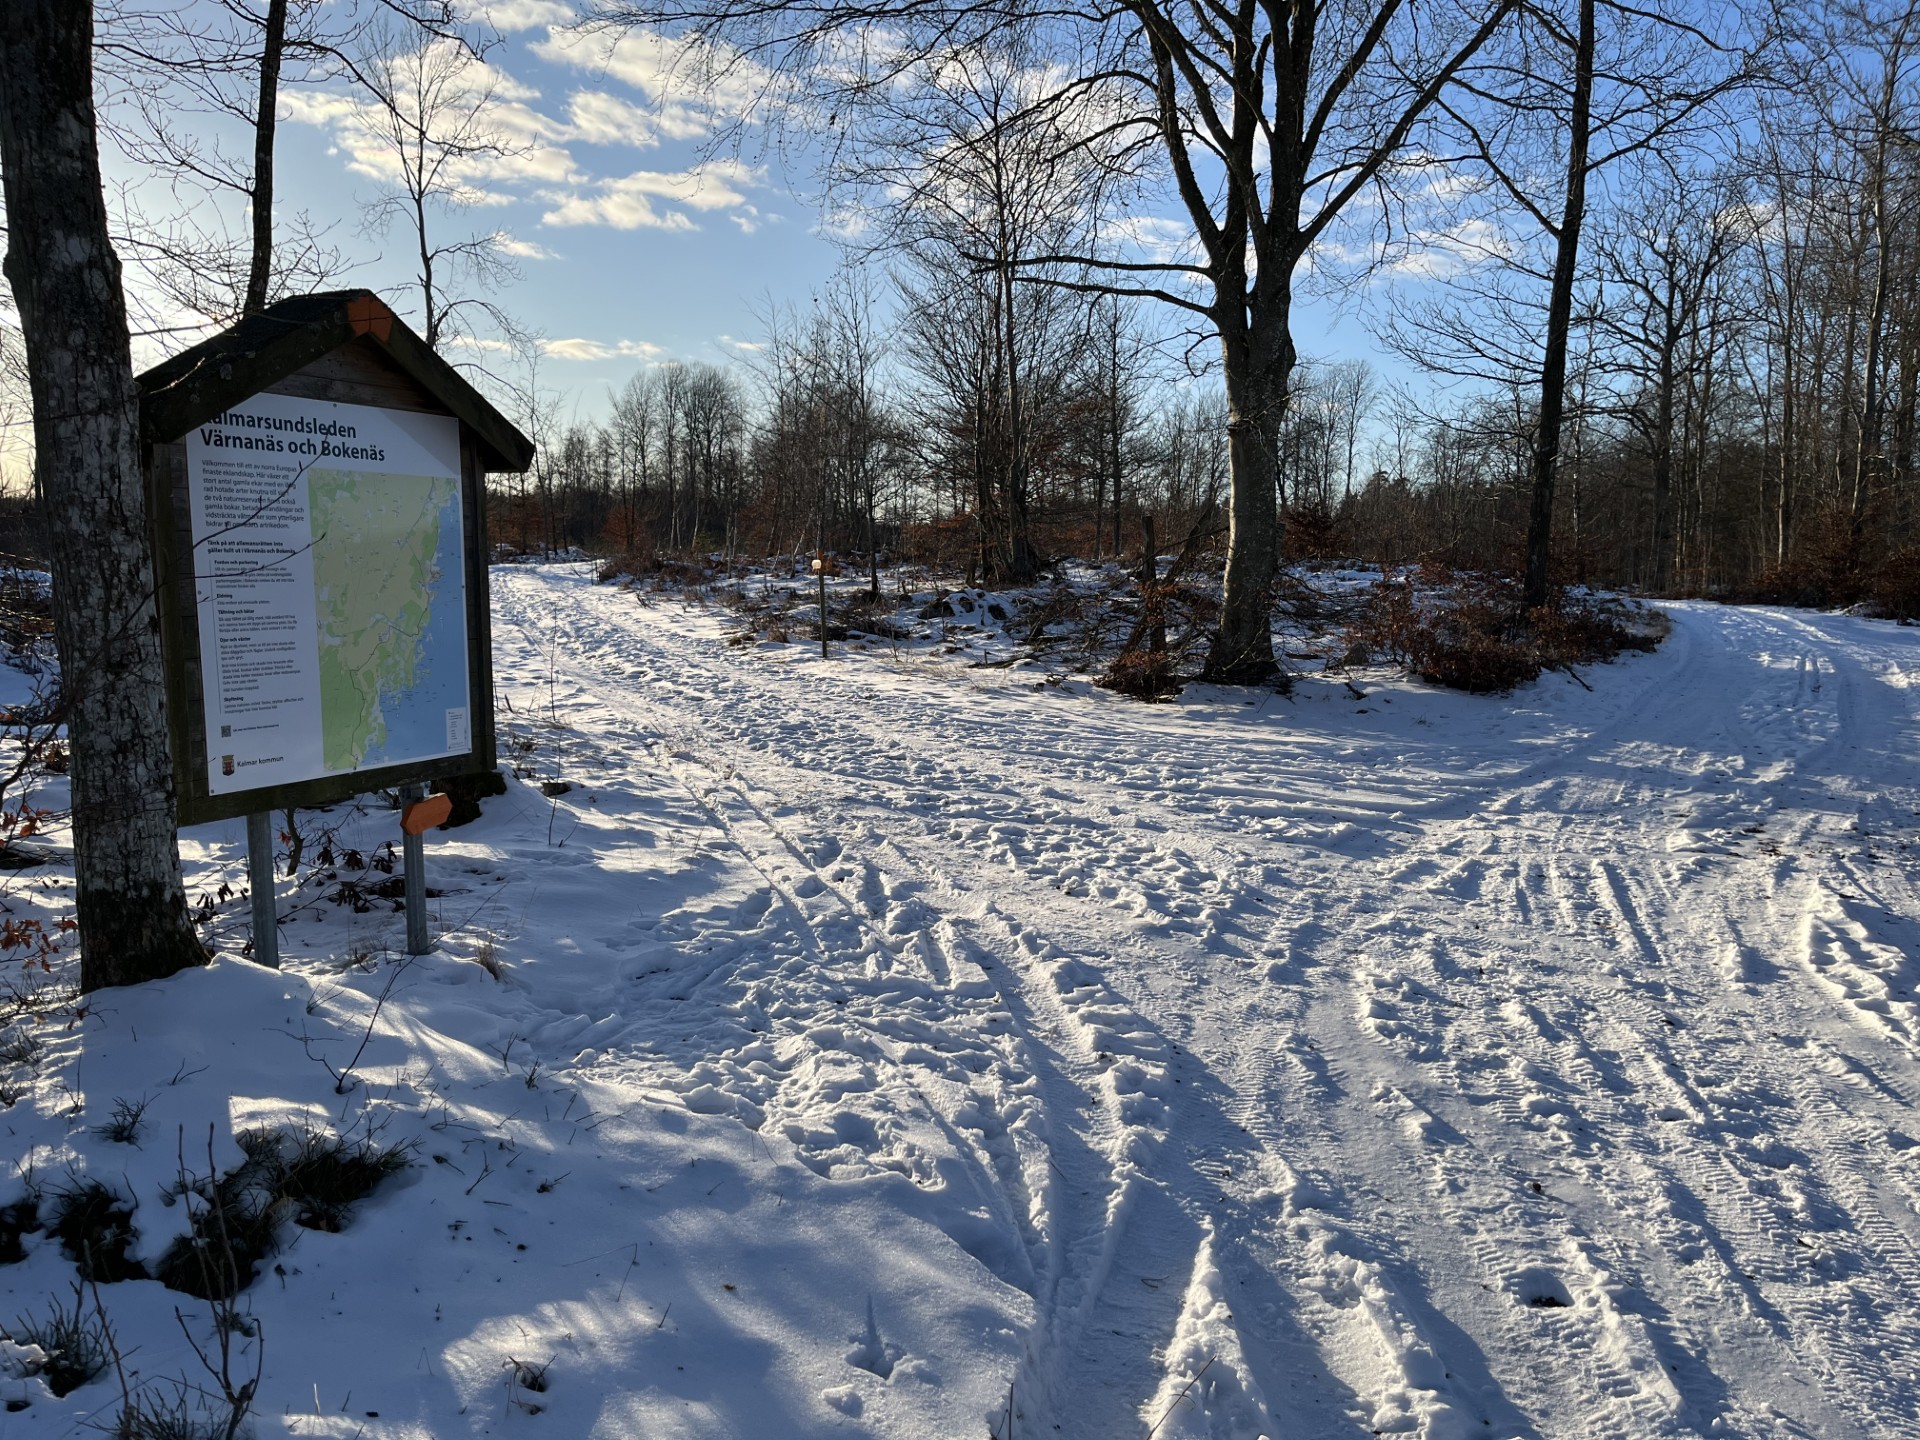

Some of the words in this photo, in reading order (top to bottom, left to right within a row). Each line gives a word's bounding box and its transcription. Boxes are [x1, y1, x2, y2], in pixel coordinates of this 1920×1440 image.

[208, 412, 356, 438] almarsundsleden
[200, 429, 284, 451] Värnanäs
[288, 439, 316, 455] och
[322, 440, 385, 461] Bokenäs
[202, 460, 236, 468] Välkommen
